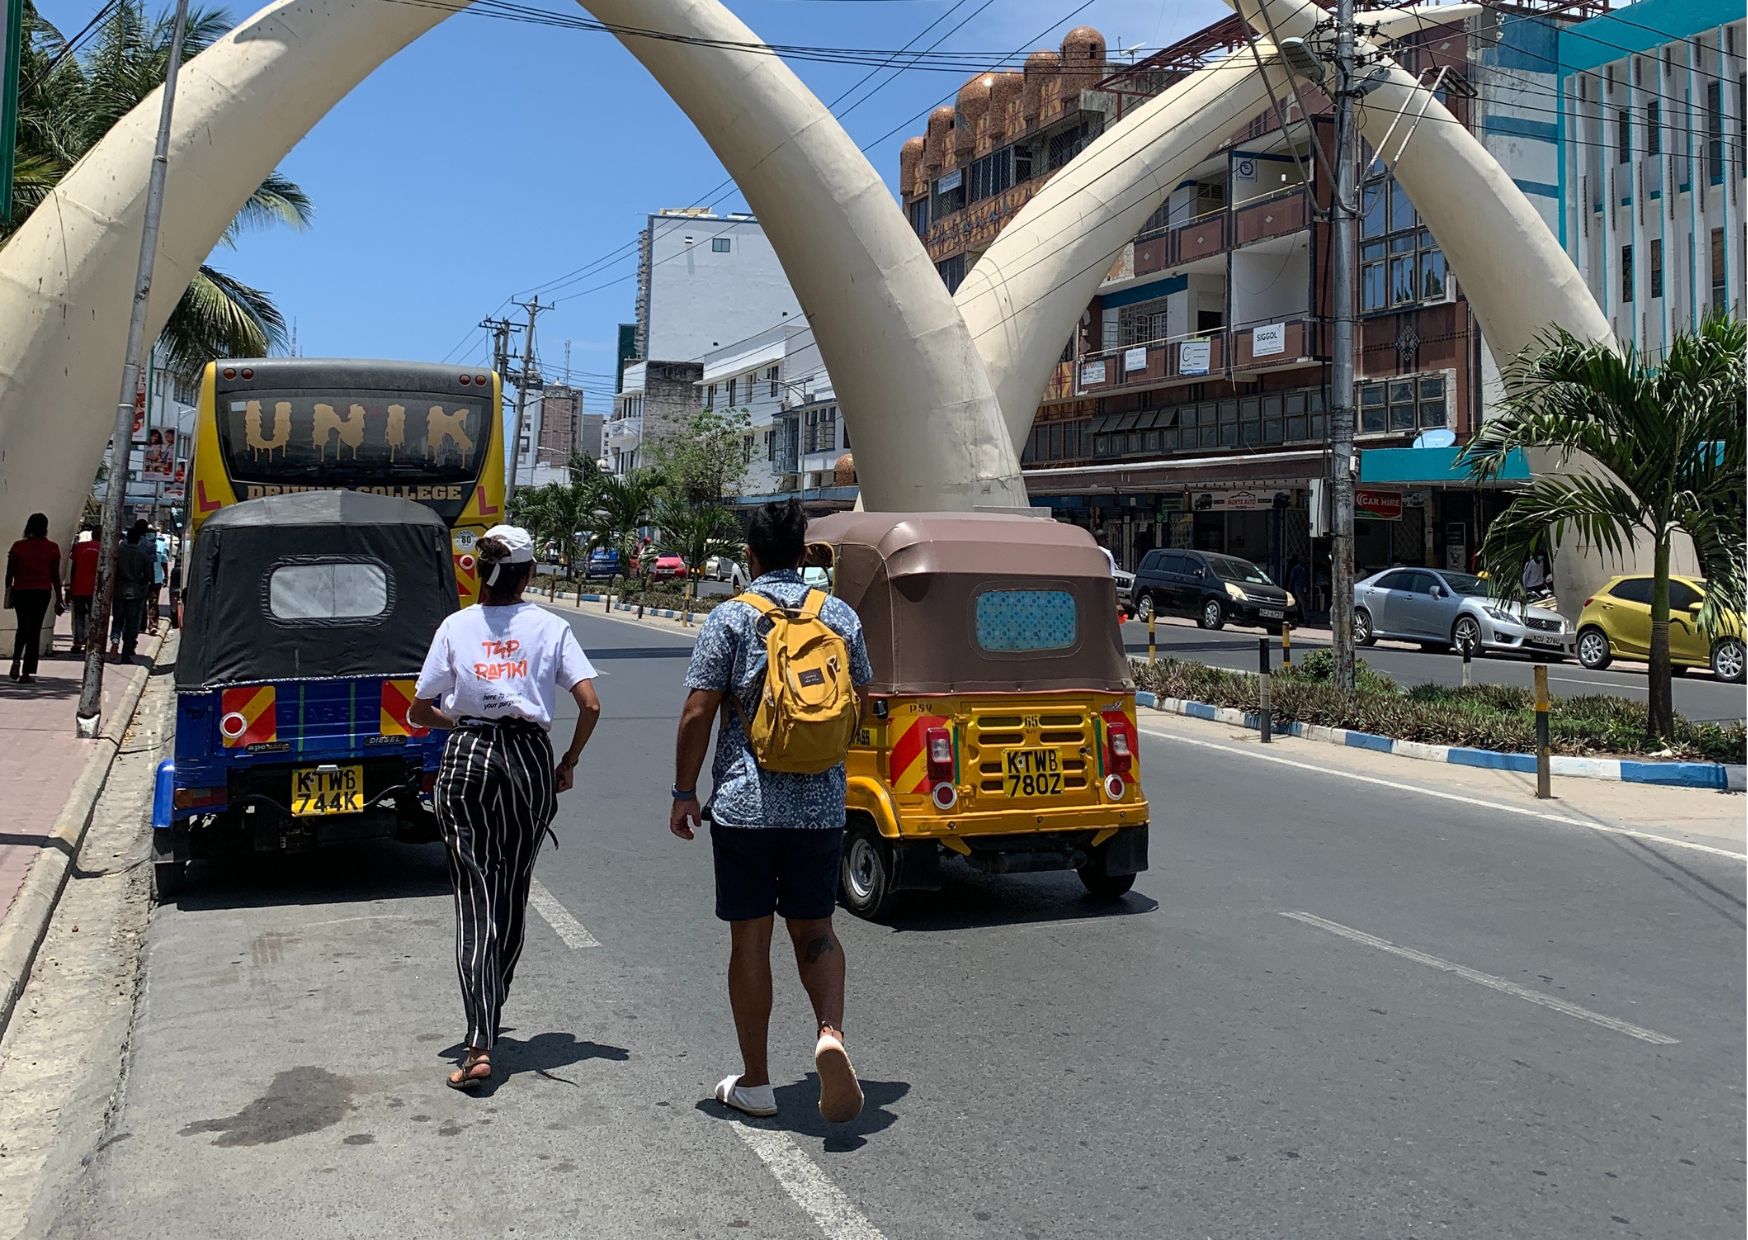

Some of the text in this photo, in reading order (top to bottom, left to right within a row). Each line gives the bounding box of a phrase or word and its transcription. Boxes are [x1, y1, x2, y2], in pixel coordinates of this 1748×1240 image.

[1256, 331, 1278, 342] SIGGOL
[245, 401, 474, 469] UNIK
[197, 480, 222, 513] L
[477, 485, 499, 516] L
[1362, 497, 1380, 506] CAR
[1381, 498, 1401, 507] HIRE
[461, 535, 472, 544] 80
[473, 659, 528, 681] RAFIKI
[483, 692, 497, 701] here
[498, 692, 506, 700] to
[483, 702, 498, 711] your
[909, 703, 934, 714] PSV
[1024, 714, 1039, 728] 65
[369, 736, 401, 744] DIESEL
[1006, 750, 1058, 774] KTWB
[297, 769, 356, 793] KTWB
[1007, 772, 1062, 798] 780Z
[296, 790, 359, 814] 744K
